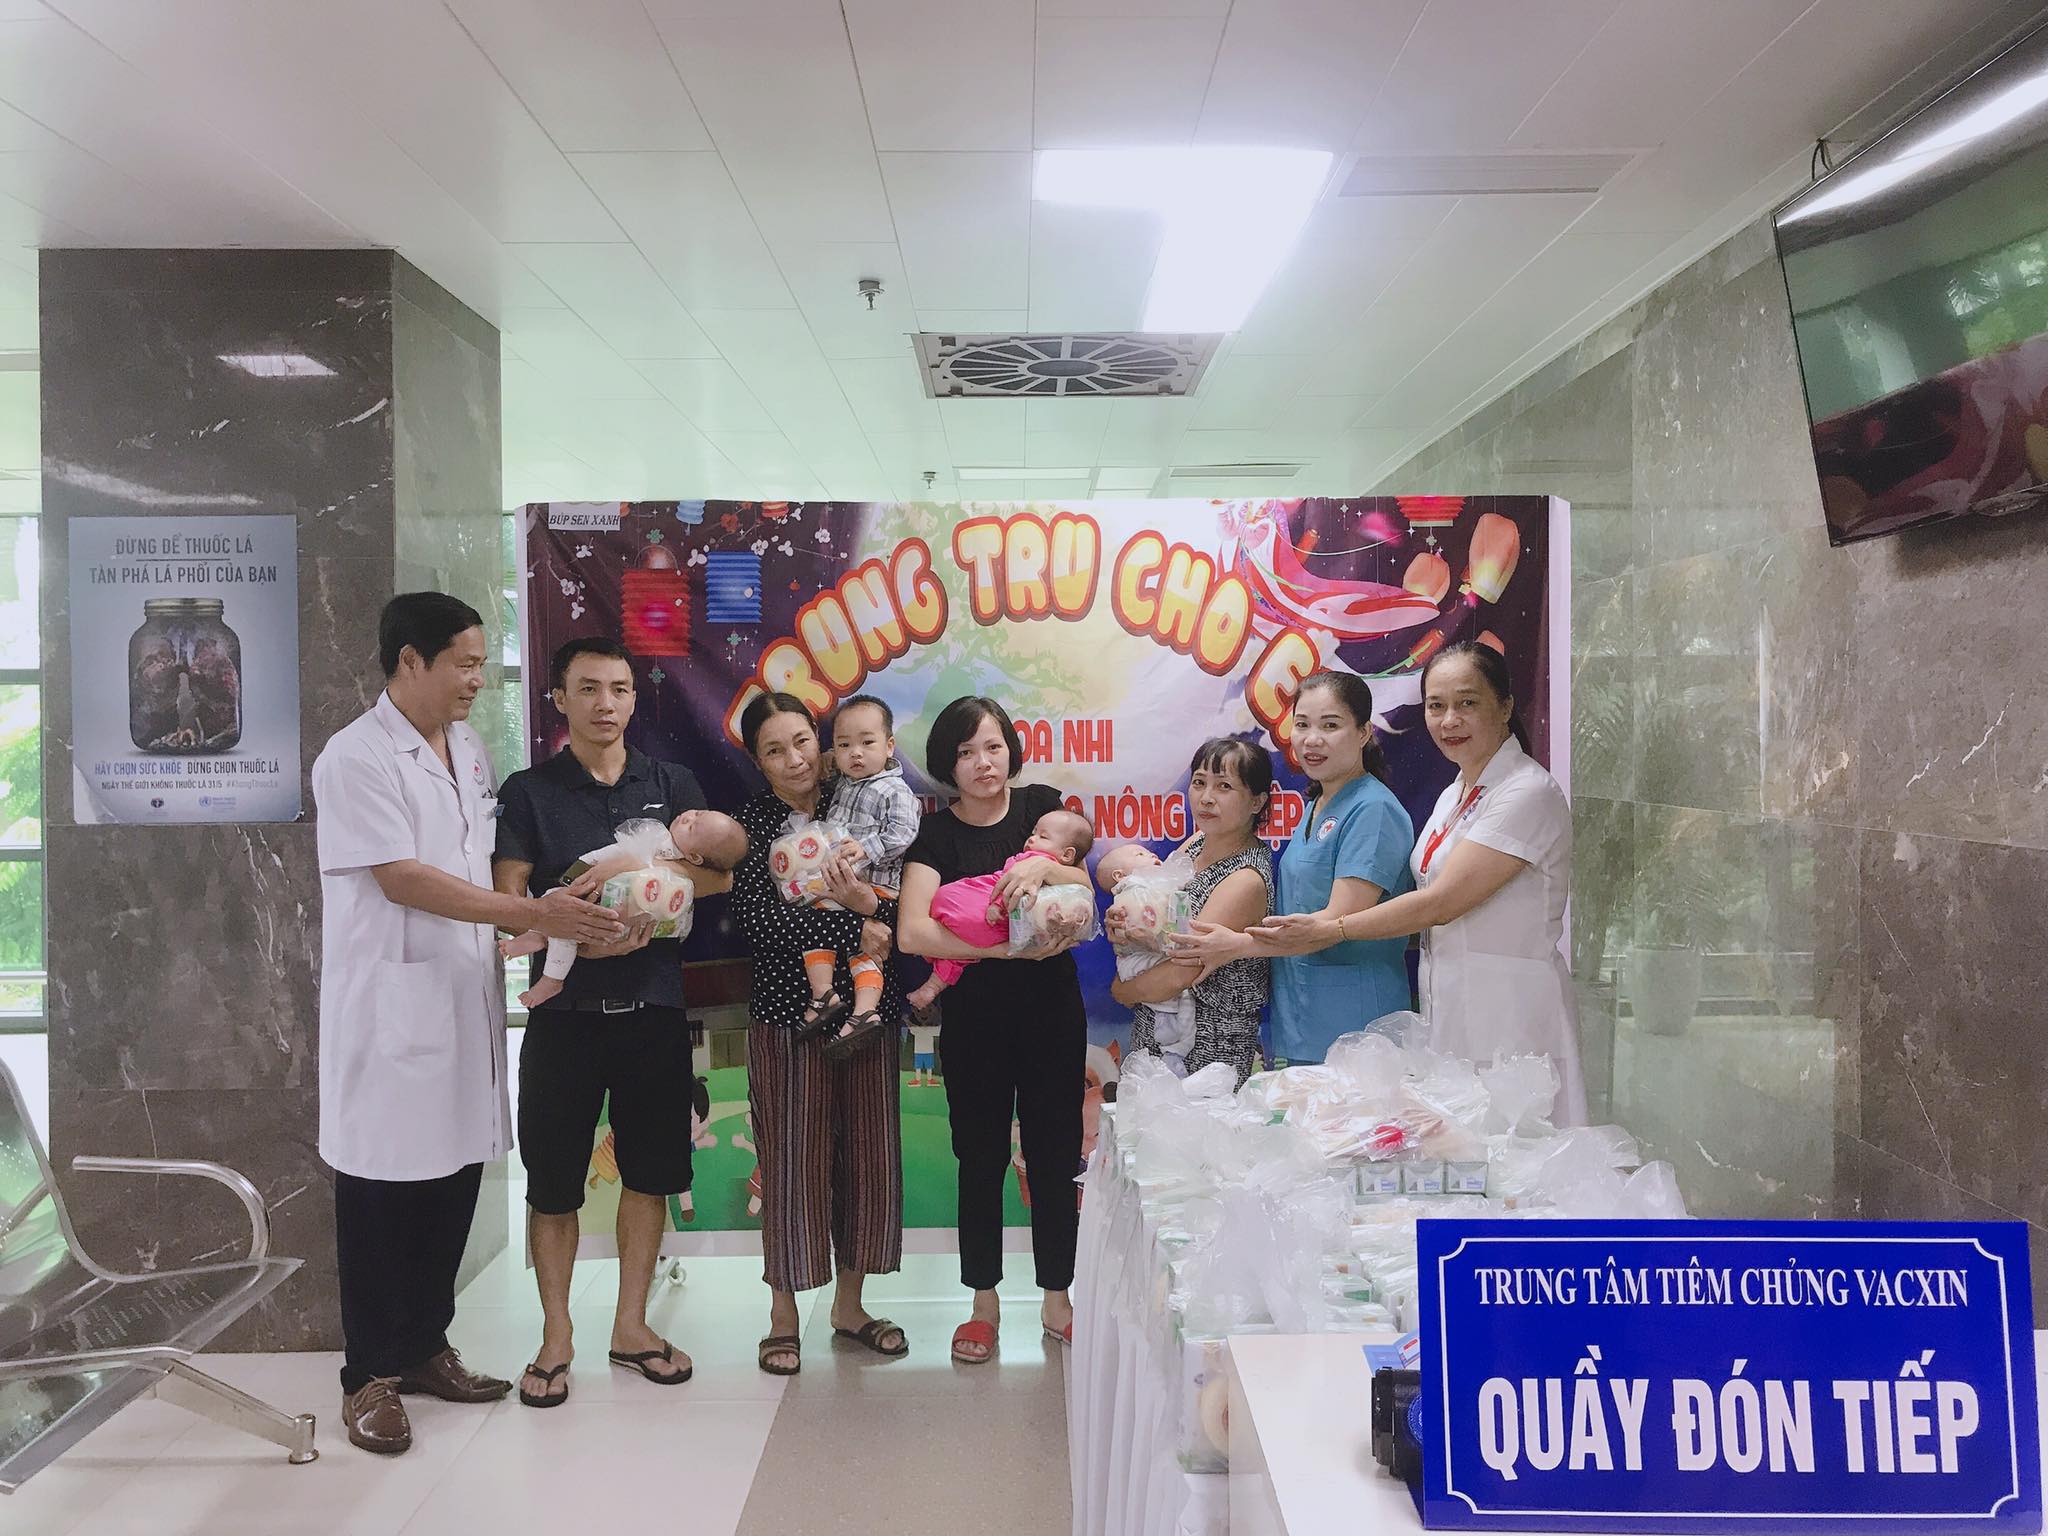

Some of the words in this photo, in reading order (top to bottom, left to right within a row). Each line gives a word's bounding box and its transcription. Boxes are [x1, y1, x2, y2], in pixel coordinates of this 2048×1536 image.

[549, 511, 570, 525] BÚP
[571, 514, 590, 525] SEN
[591, 514, 620, 525] XANH
[115, 535, 157, 555] ĐỪNG
[185, 533, 231, 554] THUỐC
[236, 534, 253, 553] LÁ
[89, 564, 117, 584] TÀN
[122, 563, 150, 584] PHÁ
[155, 564, 172, 583] LÁ
[177, 561, 210, 583] PHỔI
[216, 562, 244, 583] CỦA
[248, 566, 277, 585] BẠN
[1111, 529, 1255, 677] CHO
[1245, 625, 1322, 774] E
[1063, 719, 1113, 763] NHI
[214, 761, 237, 776] CHỌN
[239, 758, 267, 774] THUỐC
[268, 758, 280, 774] LÁ
[1095, 785, 1184, 838] NÔNG
[1474, 1267, 1577, 1305] TRUNG
[1582, 1255, 1651, 1305] TÂM
[1655, 1255, 1734, 1306] TIÊM
[1740, 1257, 1850, 1306] CHỦNG
[1853, 1268, 1968, 1307] VACXIN
[1477, 1344, 1650, 1481] QUẦY
[1672, 1358, 1815, 1473] ĐÓN
[1832, 1349, 1981, 1474] TIẾP
